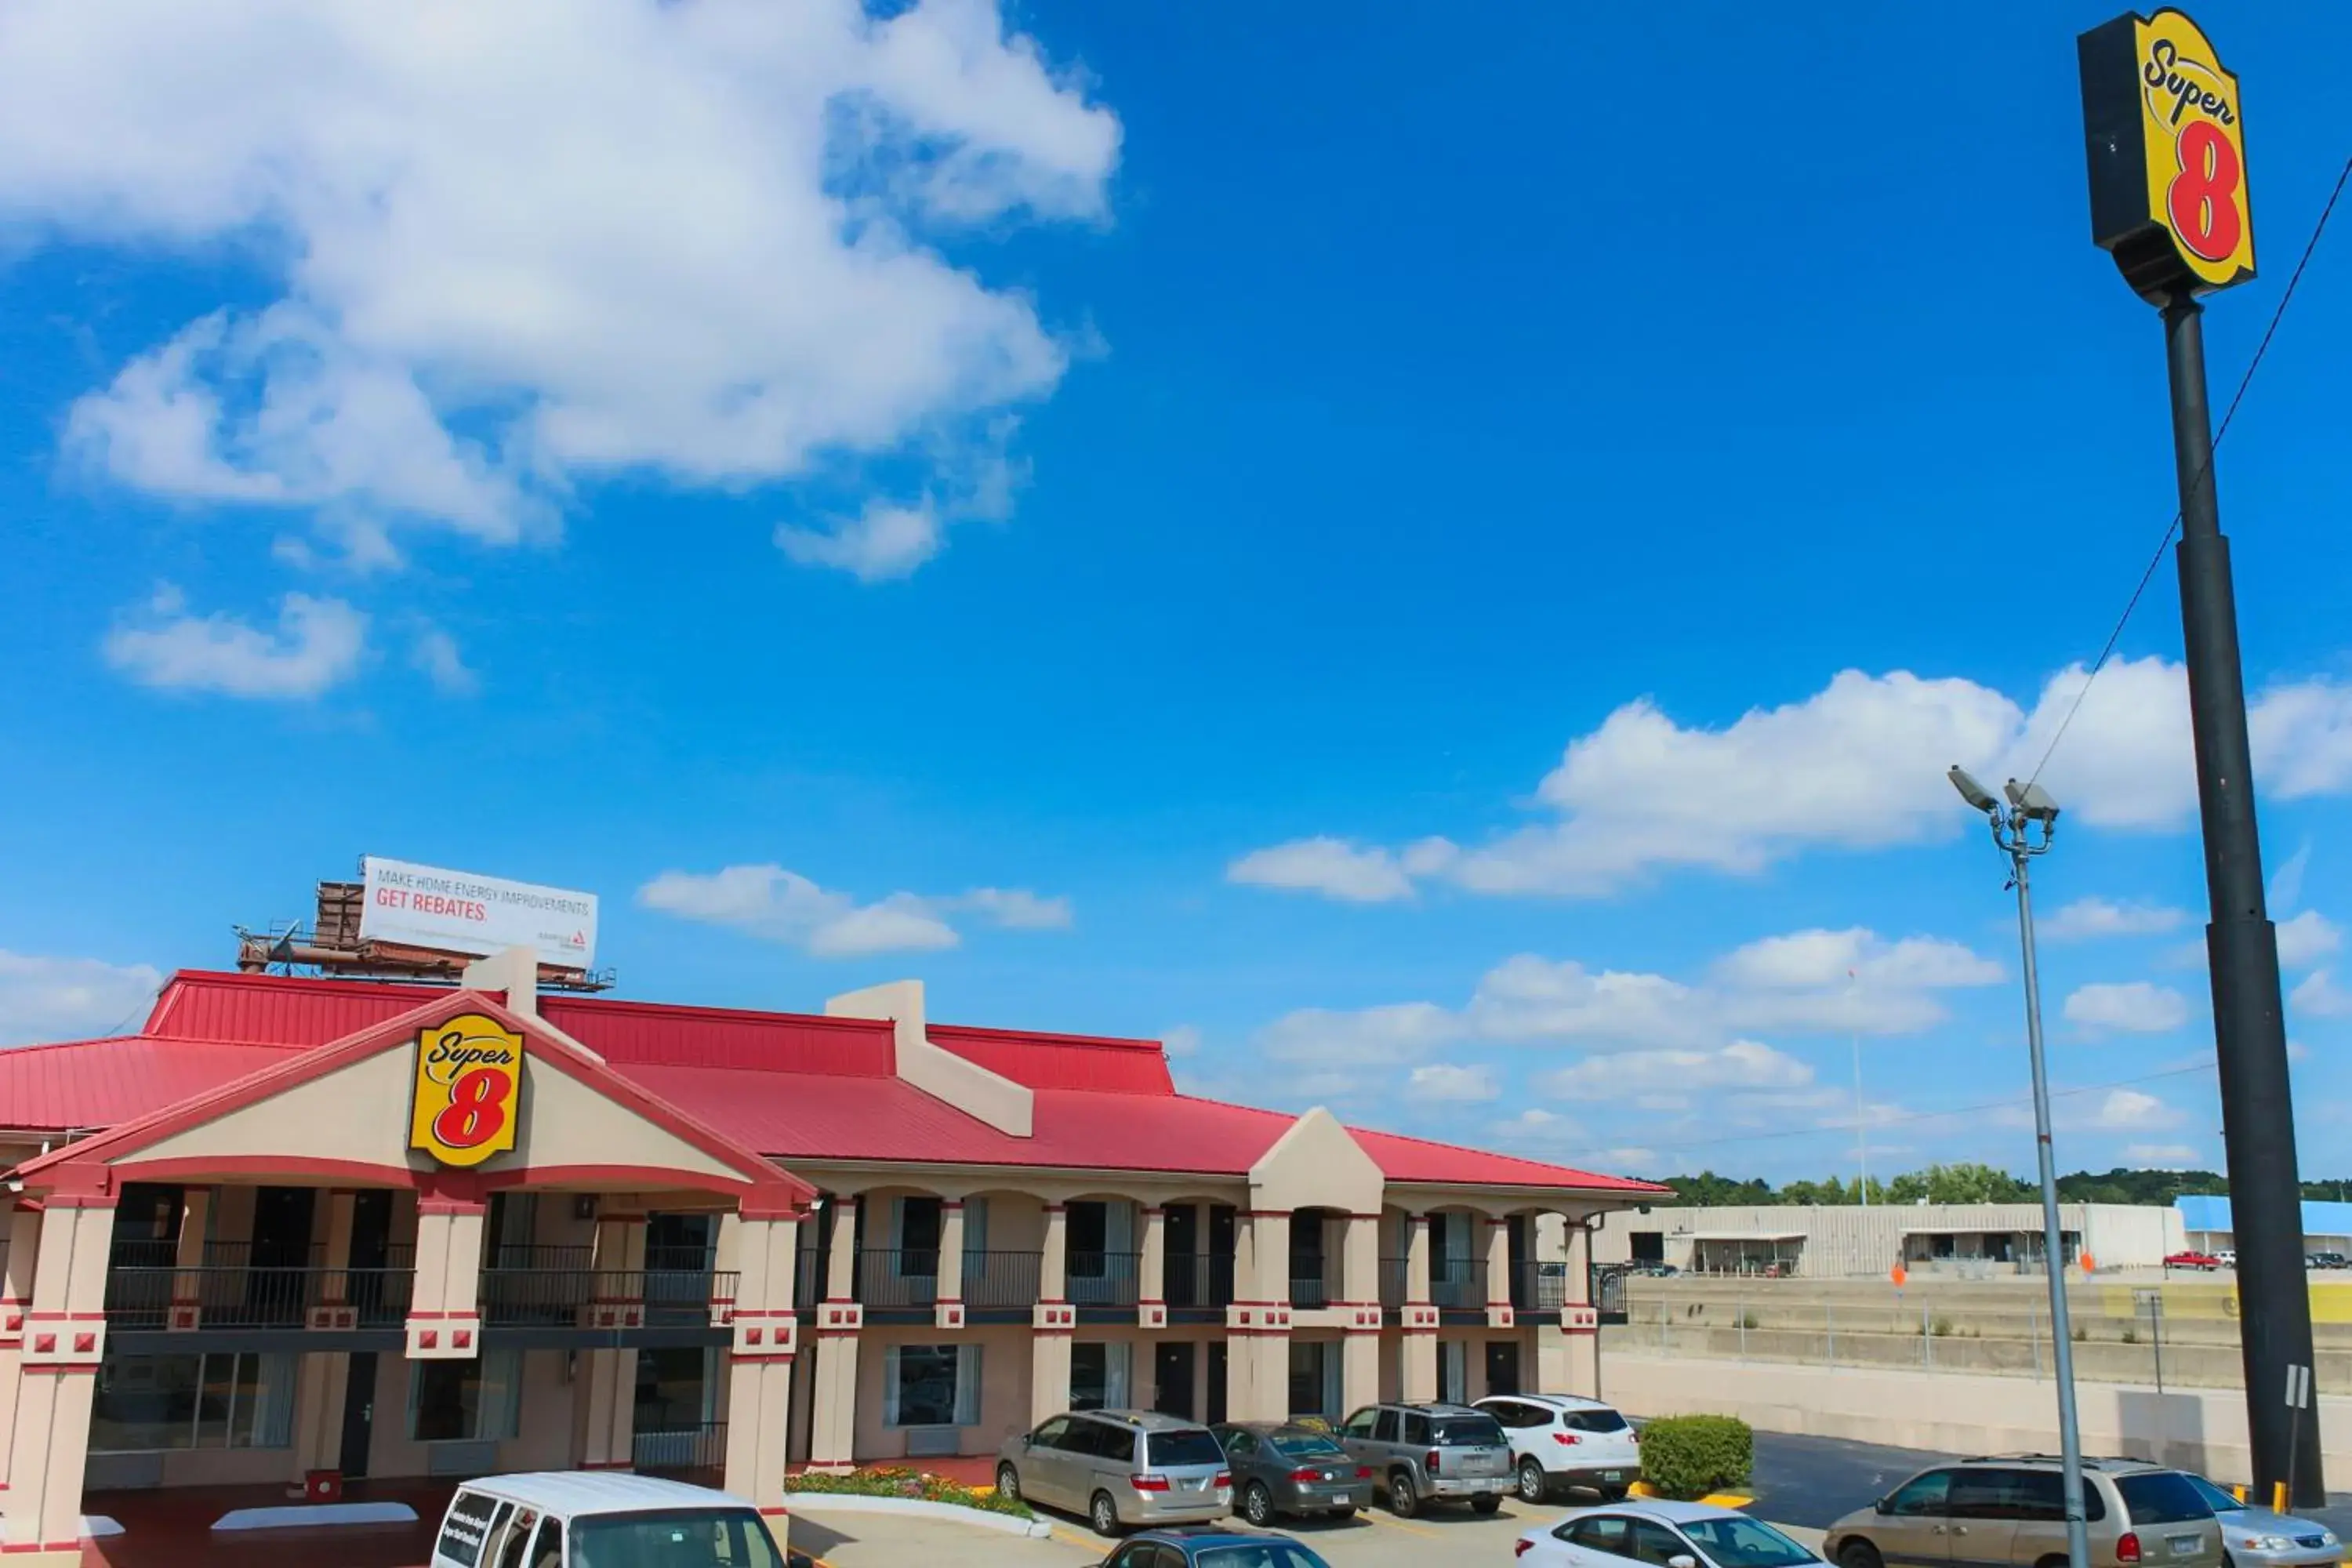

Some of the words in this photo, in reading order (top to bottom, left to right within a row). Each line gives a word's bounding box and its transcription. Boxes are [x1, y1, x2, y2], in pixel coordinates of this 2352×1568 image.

[2145, 38, 2234, 127] Super
[2166, 120, 2241, 263] 8
[376, 887, 409, 909] GET
[377, 868, 413, 887] MAKE
[416, 875, 452, 893] HOME
[454, 881, 498, 901] ENERGY
[499, 889, 589, 916] IMPROVEMENTS
[427, 1031, 514, 1080] Super
[432, 1068, 512, 1149] 8
